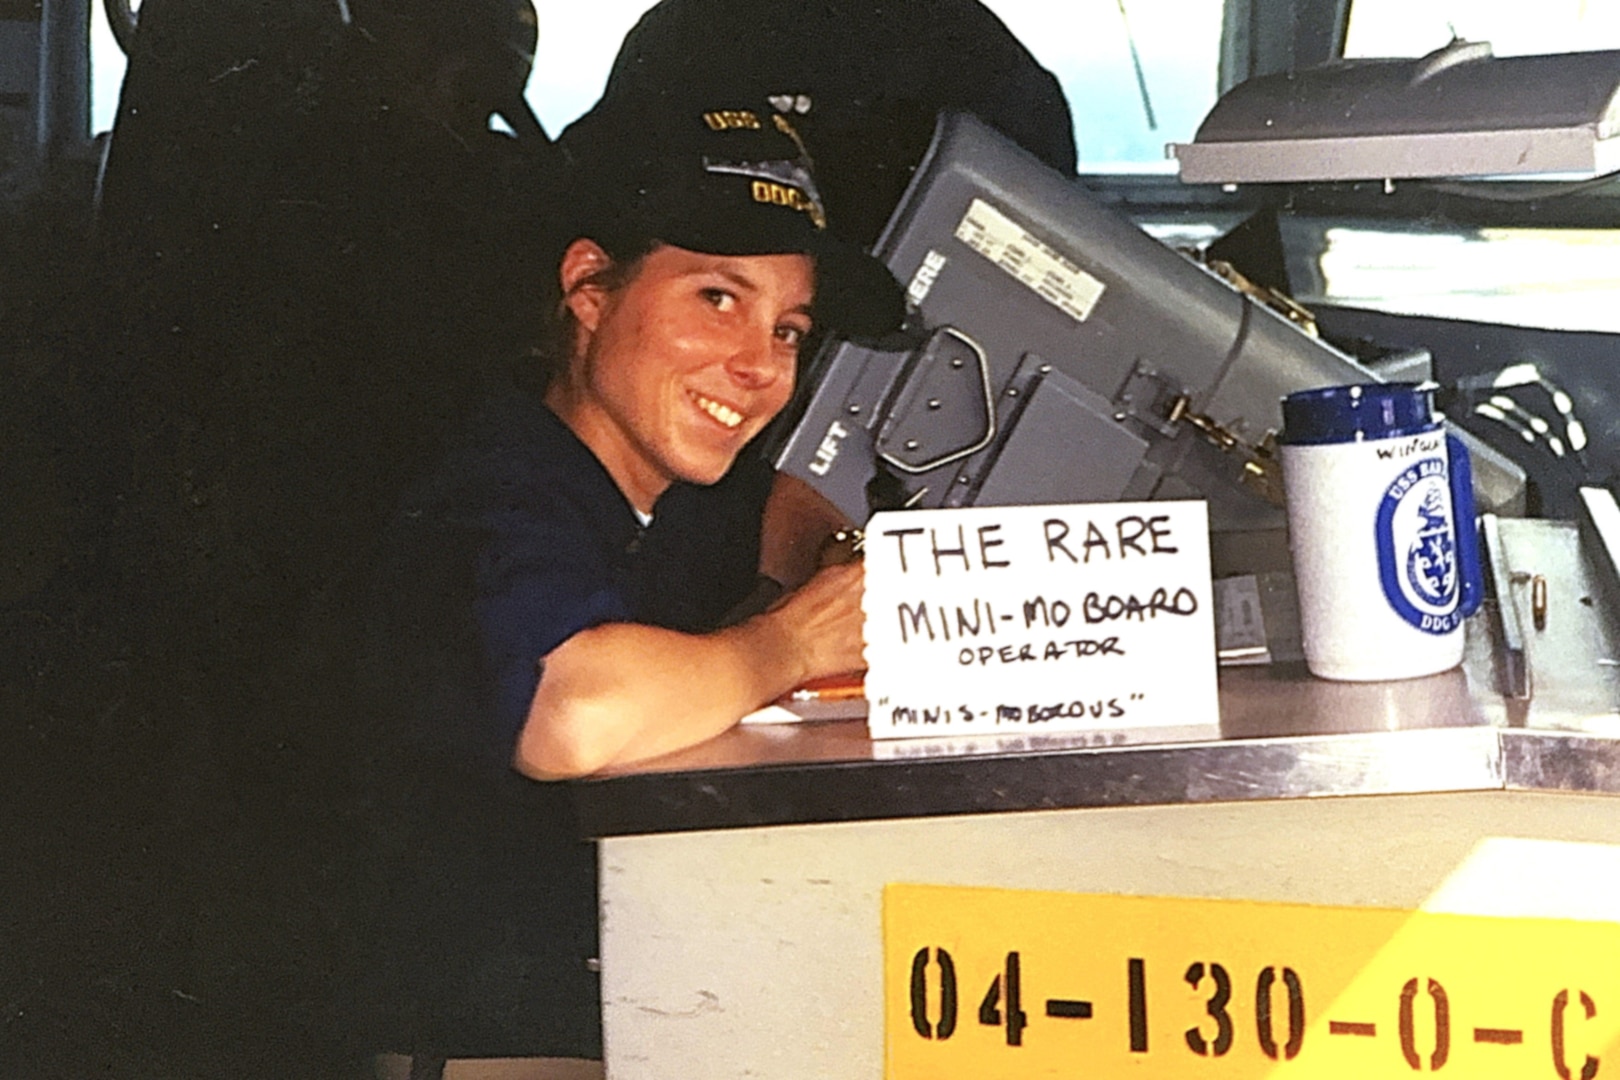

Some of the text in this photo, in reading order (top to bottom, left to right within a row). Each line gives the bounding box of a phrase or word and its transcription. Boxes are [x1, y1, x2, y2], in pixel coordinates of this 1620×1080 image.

[808, 420, 848, 476] LIFT
[1389, 470, 1417, 499] USS
[883, 515, 1179, 576] THE RARE
[897, 586, 1198, 643] MINI-MO BOARD
[1421, 614, 1451, 631] DDG
[958, 636, 1126, 666] OPERATOR
